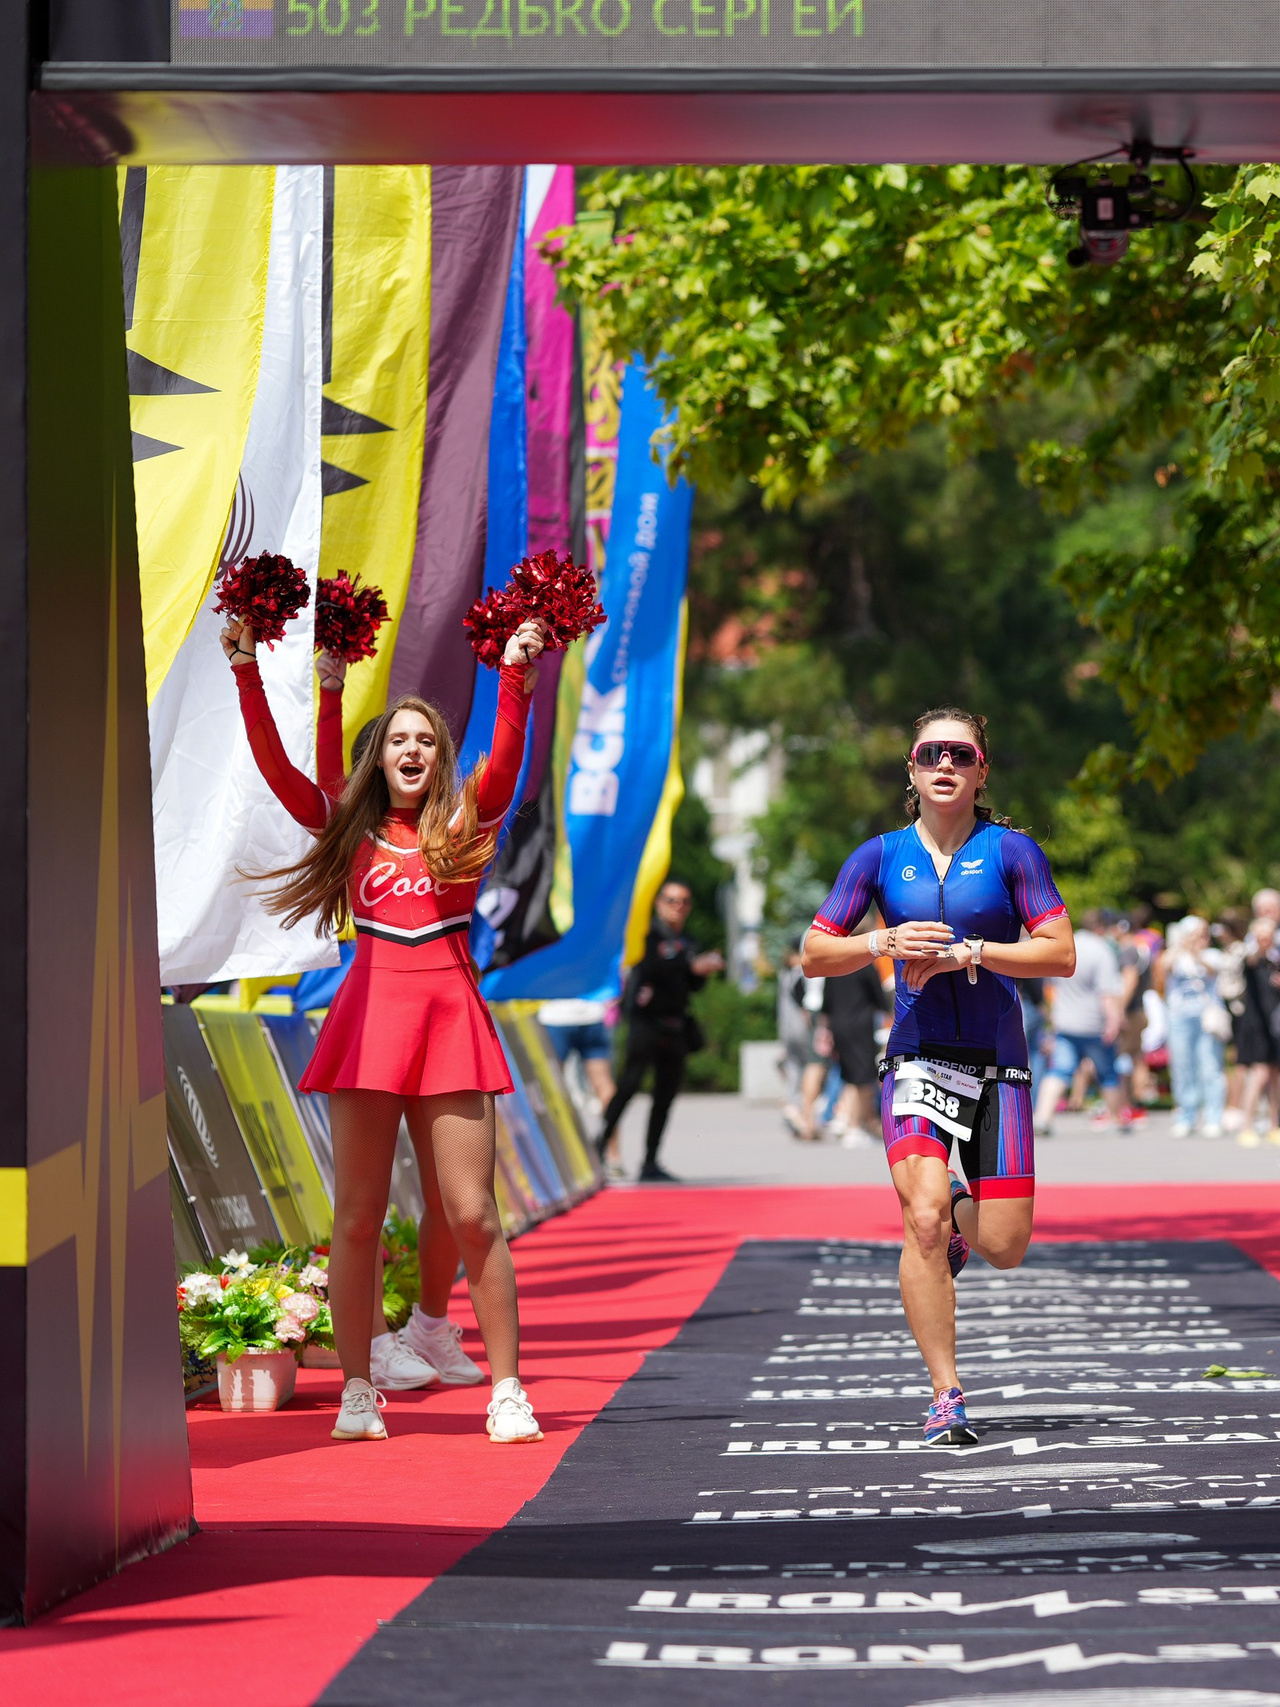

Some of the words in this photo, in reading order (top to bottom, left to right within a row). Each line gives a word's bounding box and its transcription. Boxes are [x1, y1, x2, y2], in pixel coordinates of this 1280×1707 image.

[909, 1080, 960, 1119] 3258
[692, 1505, 963, 1521] IRON
[637, 1590, 963, 1608] IRON
[606, 1640, 965, 1664] IRON
